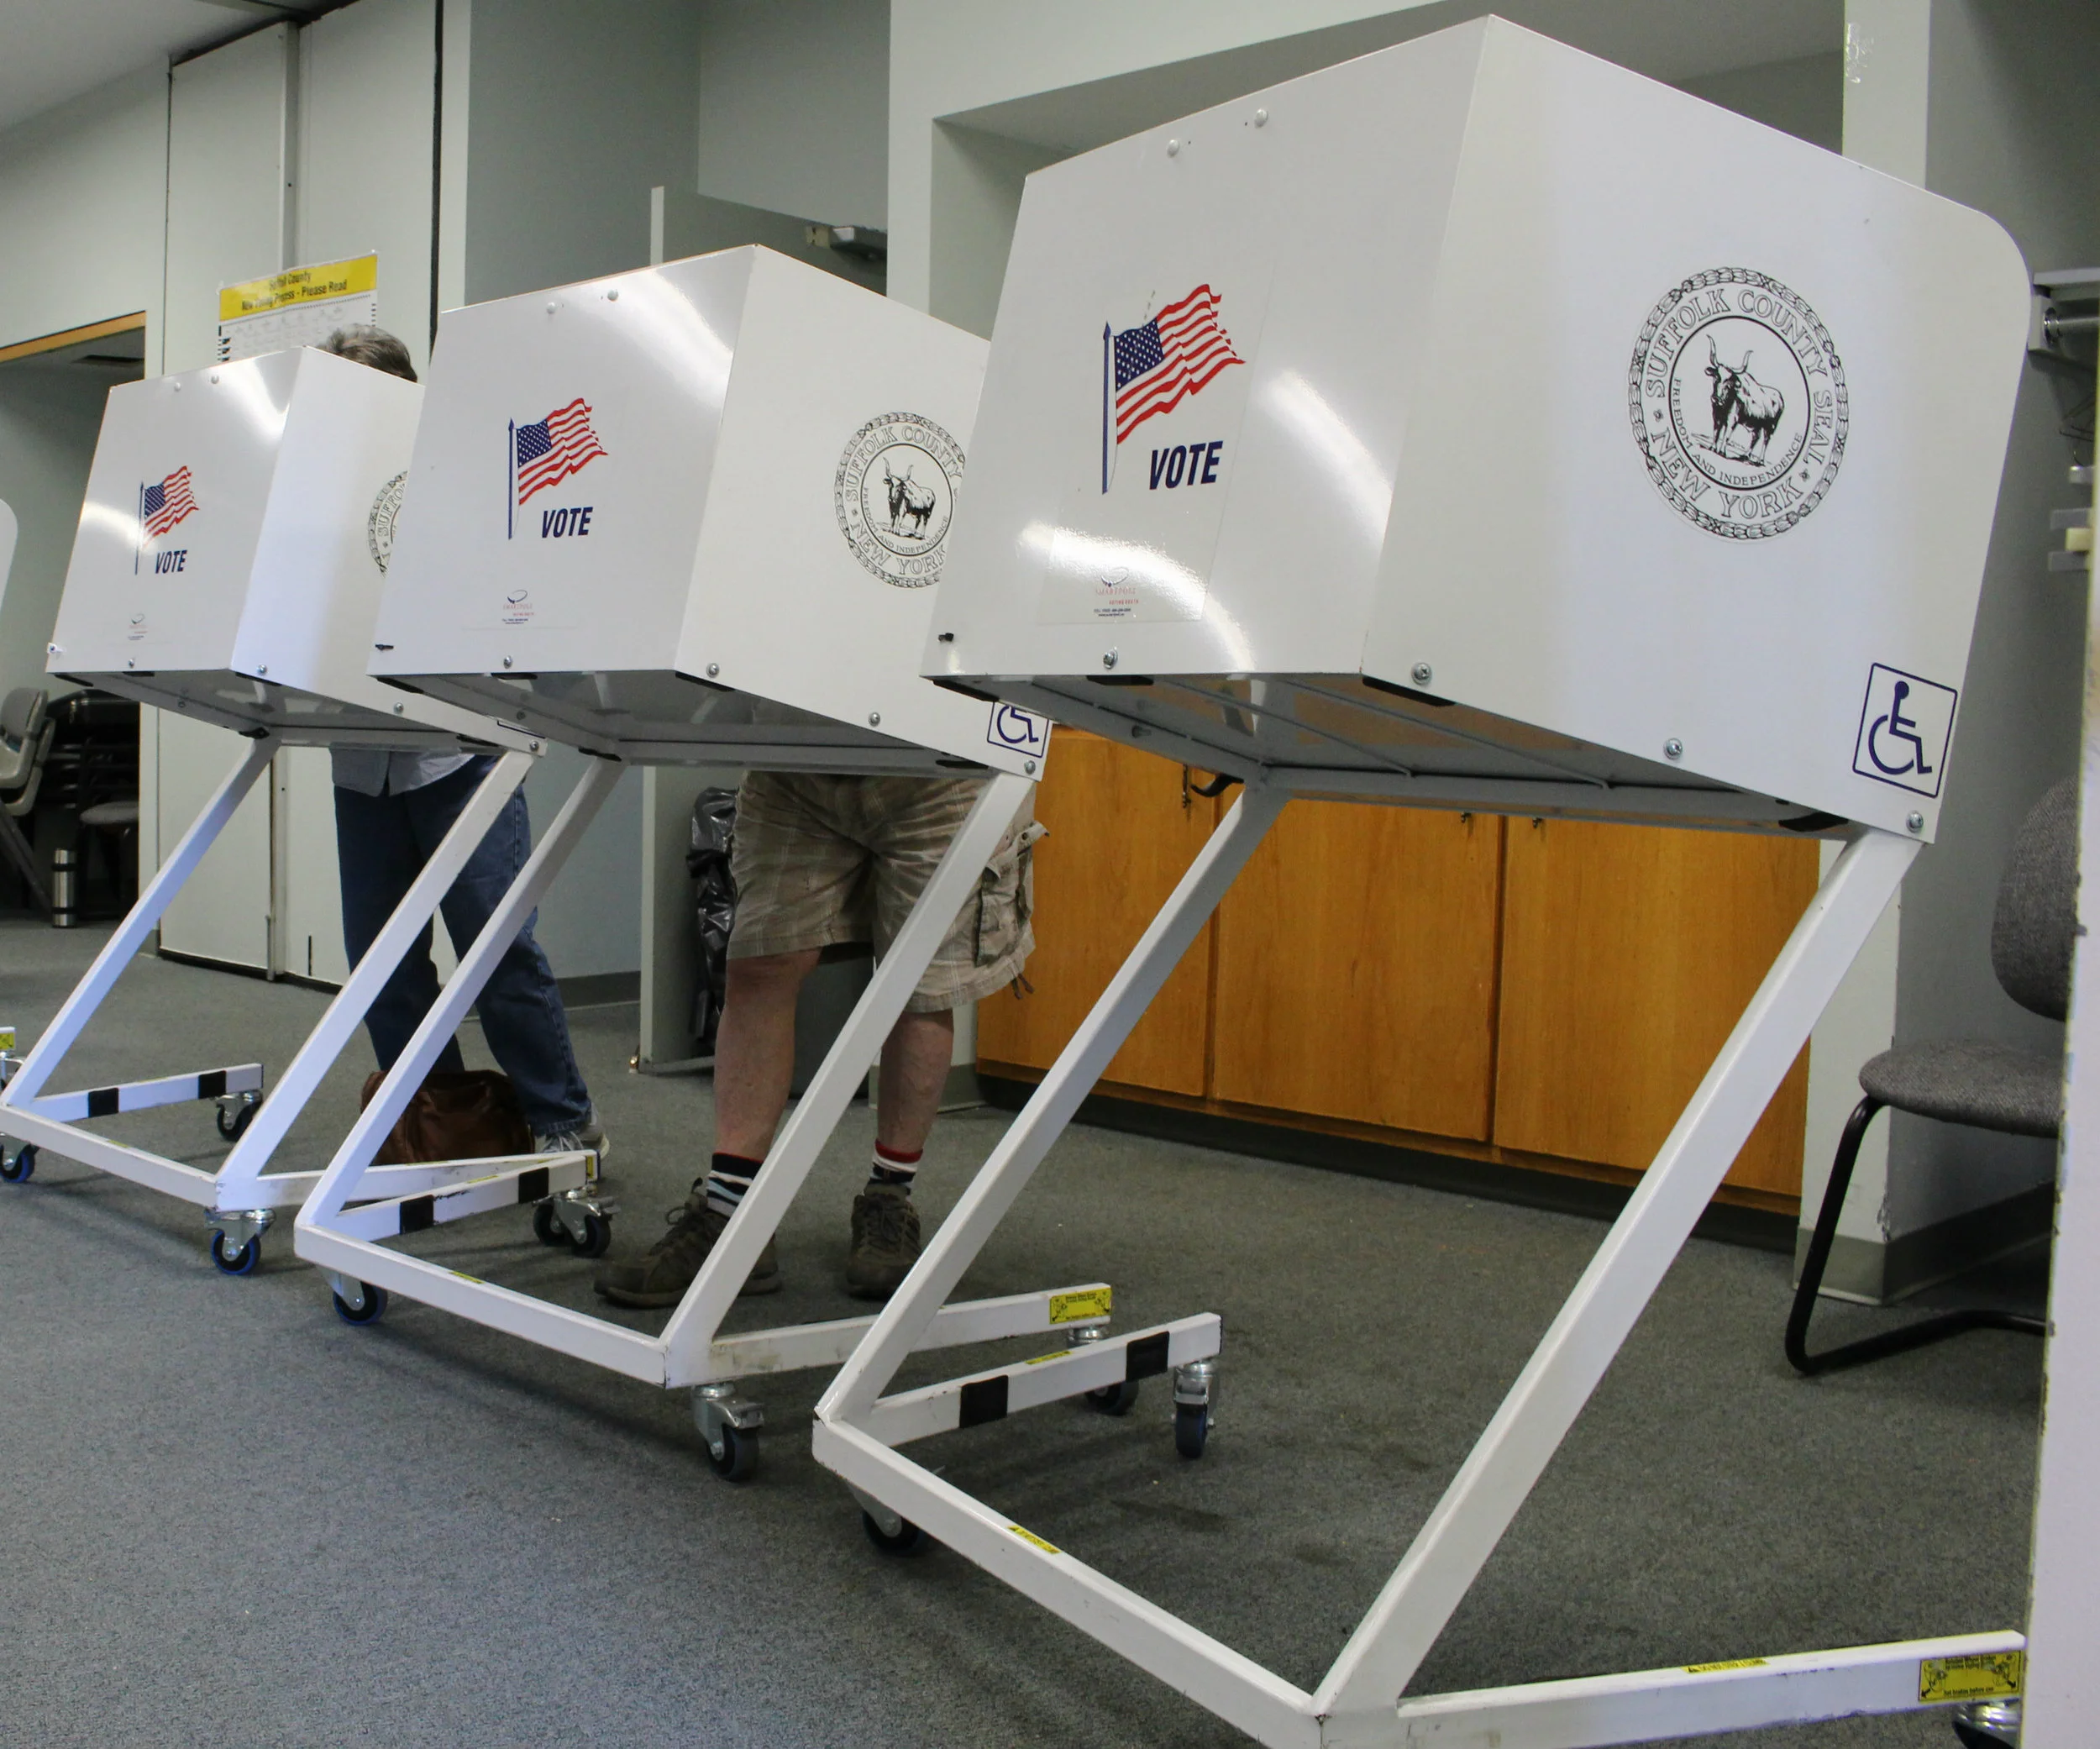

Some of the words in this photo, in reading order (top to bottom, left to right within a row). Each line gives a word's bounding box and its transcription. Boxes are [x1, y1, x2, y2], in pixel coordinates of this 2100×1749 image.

[302, 285, 327, 297] Please
[329, 279, 348, 292] Read
[1646, 289, 1730, 398] SUFFOLK
[1738, 290, 1828, 376] COUNTY
[1803, 390, 1832, 465] SEAL
[1672, 379, 1693, 449] FREEDOM
[1692, 453, 1716, 475] AND
[1719, 433, 1803, 485] INDEPENDENCE
[846, 426, 898, 502] SUFFOLK
[901, 426, 963, 478] COUNTY
[1149, 440, 1223, 490] VOTE
[1651, 428, 1711, 502] NEW
[1718, 476, 1803, 519] YORK
[542, 507, 593, 538] VOTE
[851, 519, 891, 566] NEW
[879, 535, 895, 549] AND
[896, 516, 948, 554] INDEPENDENCE
[155, 549, 187, 574] VOTE
